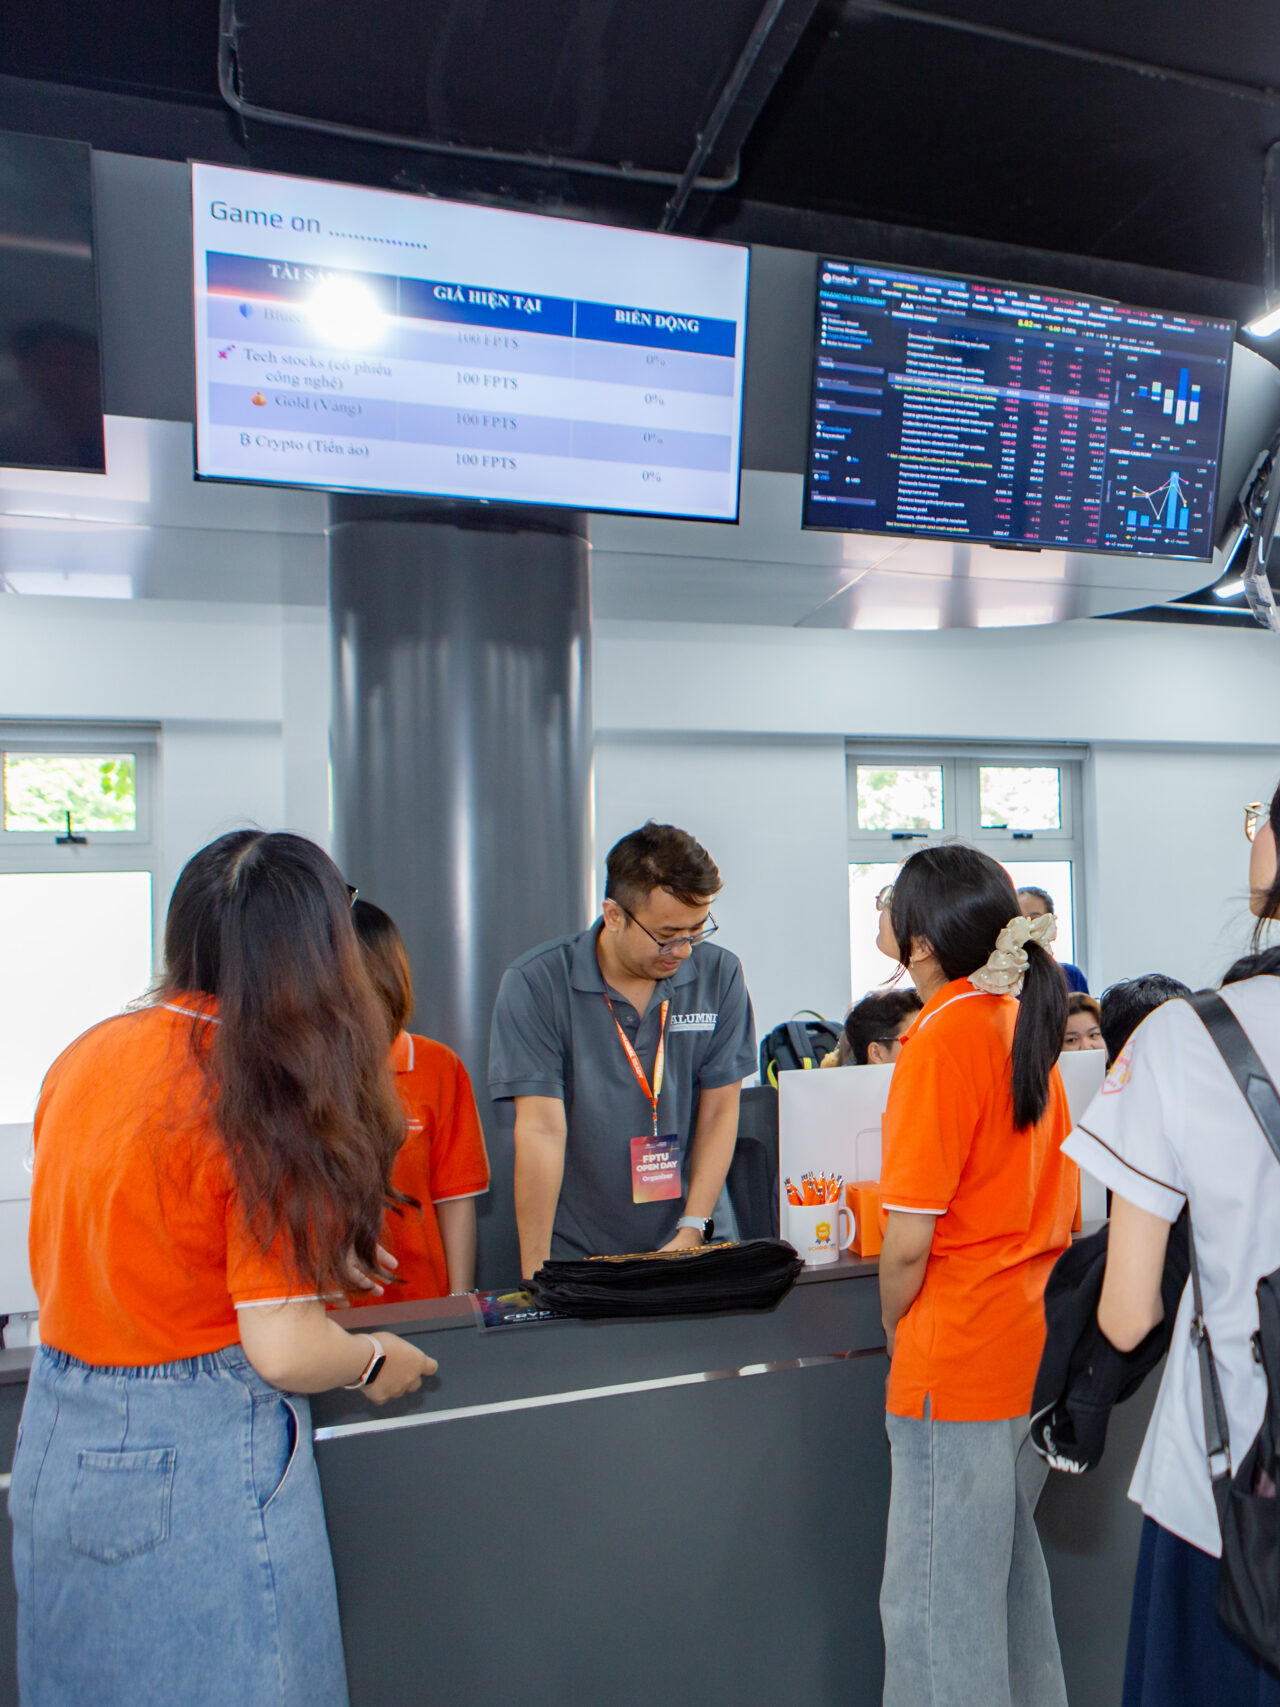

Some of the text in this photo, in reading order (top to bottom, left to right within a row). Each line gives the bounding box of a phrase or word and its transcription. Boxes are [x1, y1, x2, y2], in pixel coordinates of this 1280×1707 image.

[210, 200, 283, 229] Game
[291, 216, 320, 233] on
[513, 296, 542, 315] TẠI
[457, 332, 520, 350] 100 FPTS
[244, 348, 278, 366] Tech
[282, 351, 324, 369] stocks
[645, 354, 666, 368] 0%
[456, 371, 519, 390] 100 FPTS
[275, 395, 310, 410] Gold
[644, 393, 665, 407] 0%
[456, 412, 517, 430] 100 FPTS
[255, 435, 304, 453] Crypto
[643, 432, 663, 445] 0%
[455, 452, 517, 470] 100 FPTS
[642, 470, 662, 483] 0%
[670, 1012, 718, 1025] ALUMNI
[642, 1152, 669, 1163] FPTU
[636, 1160, 678, 1172] OPEN DAY
